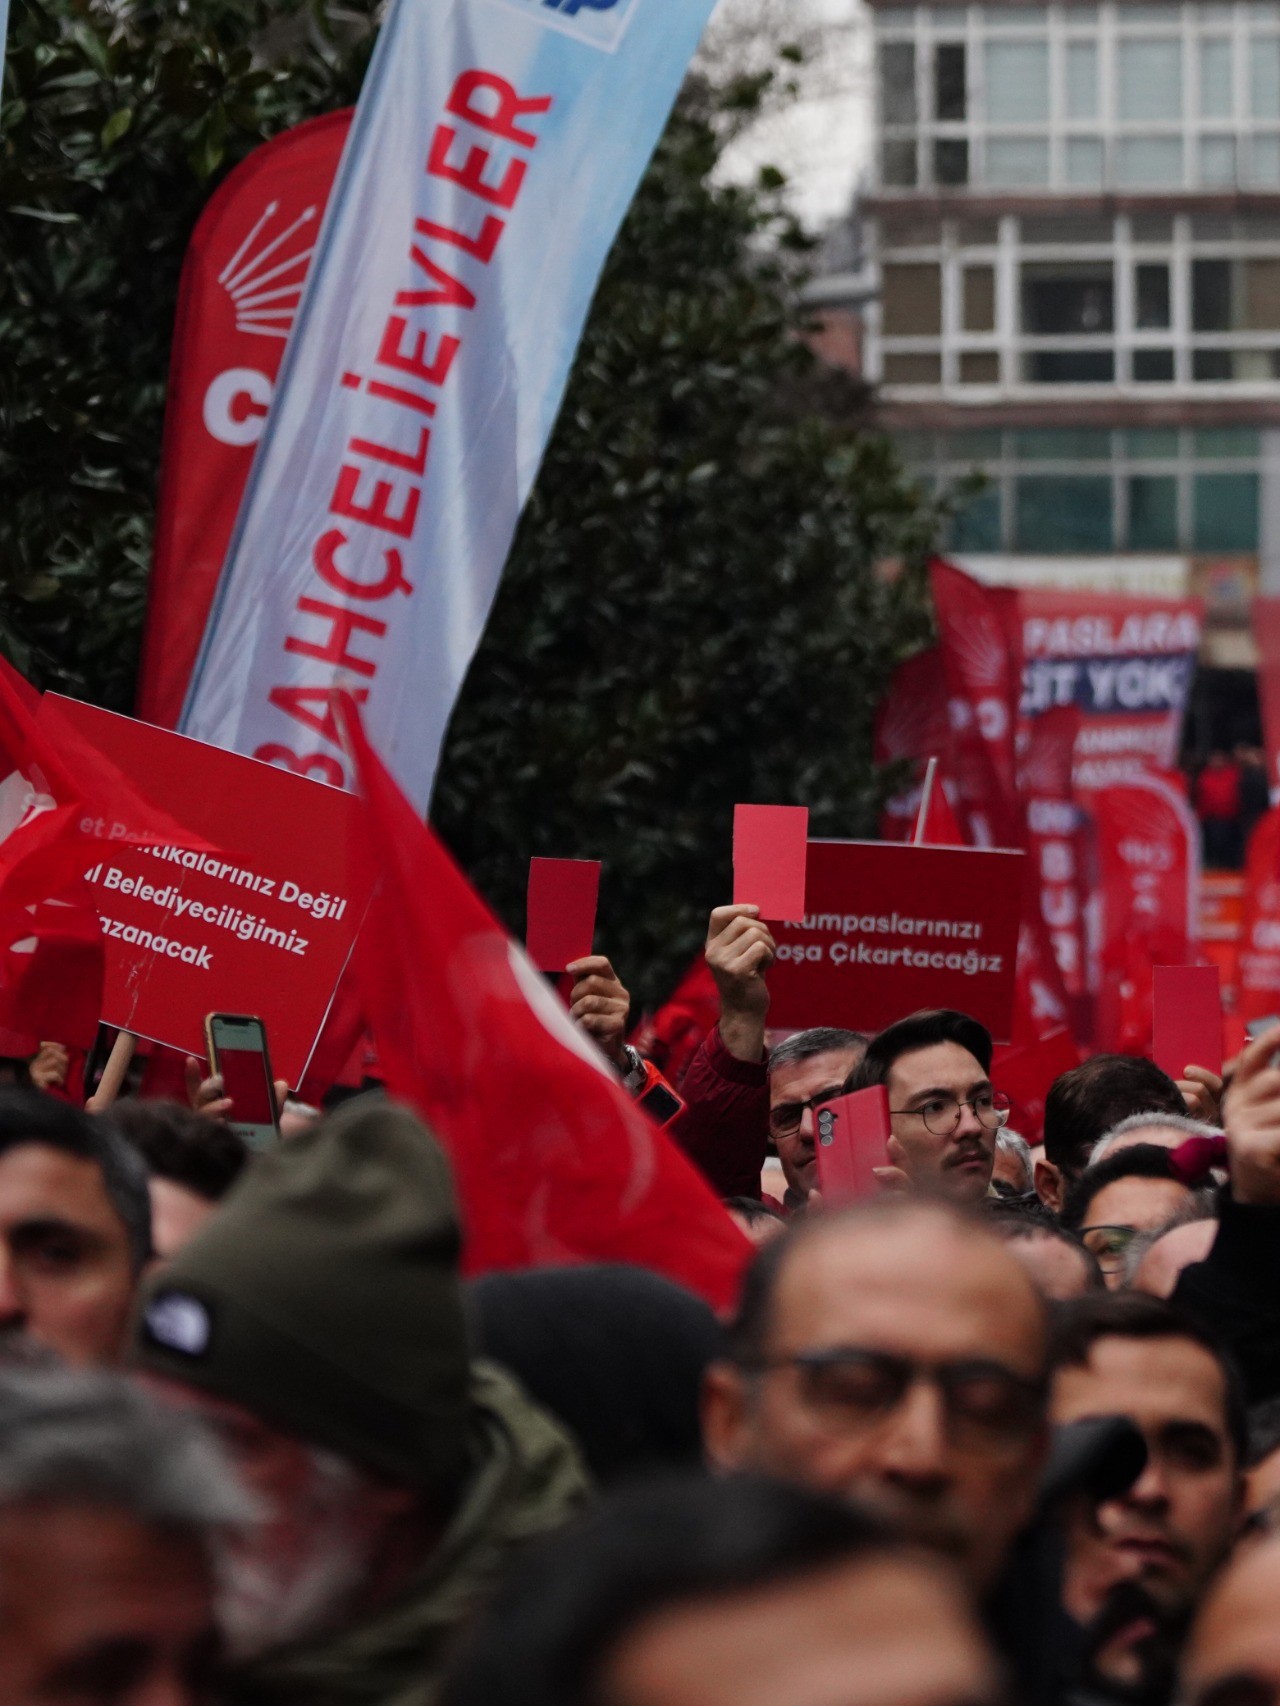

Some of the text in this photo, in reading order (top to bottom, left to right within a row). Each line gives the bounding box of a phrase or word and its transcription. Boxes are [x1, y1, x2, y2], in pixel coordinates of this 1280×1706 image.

[252, 67, 553, 788] BAHÇELİEVLER
[103, 867, 310, 956] Belediyeciliğimiz
[278, 881, 348, 921] Değil
[97, 914, 214, 970] azanacak
[775, 942, 1003, 975] oşa Çıkartacağız
